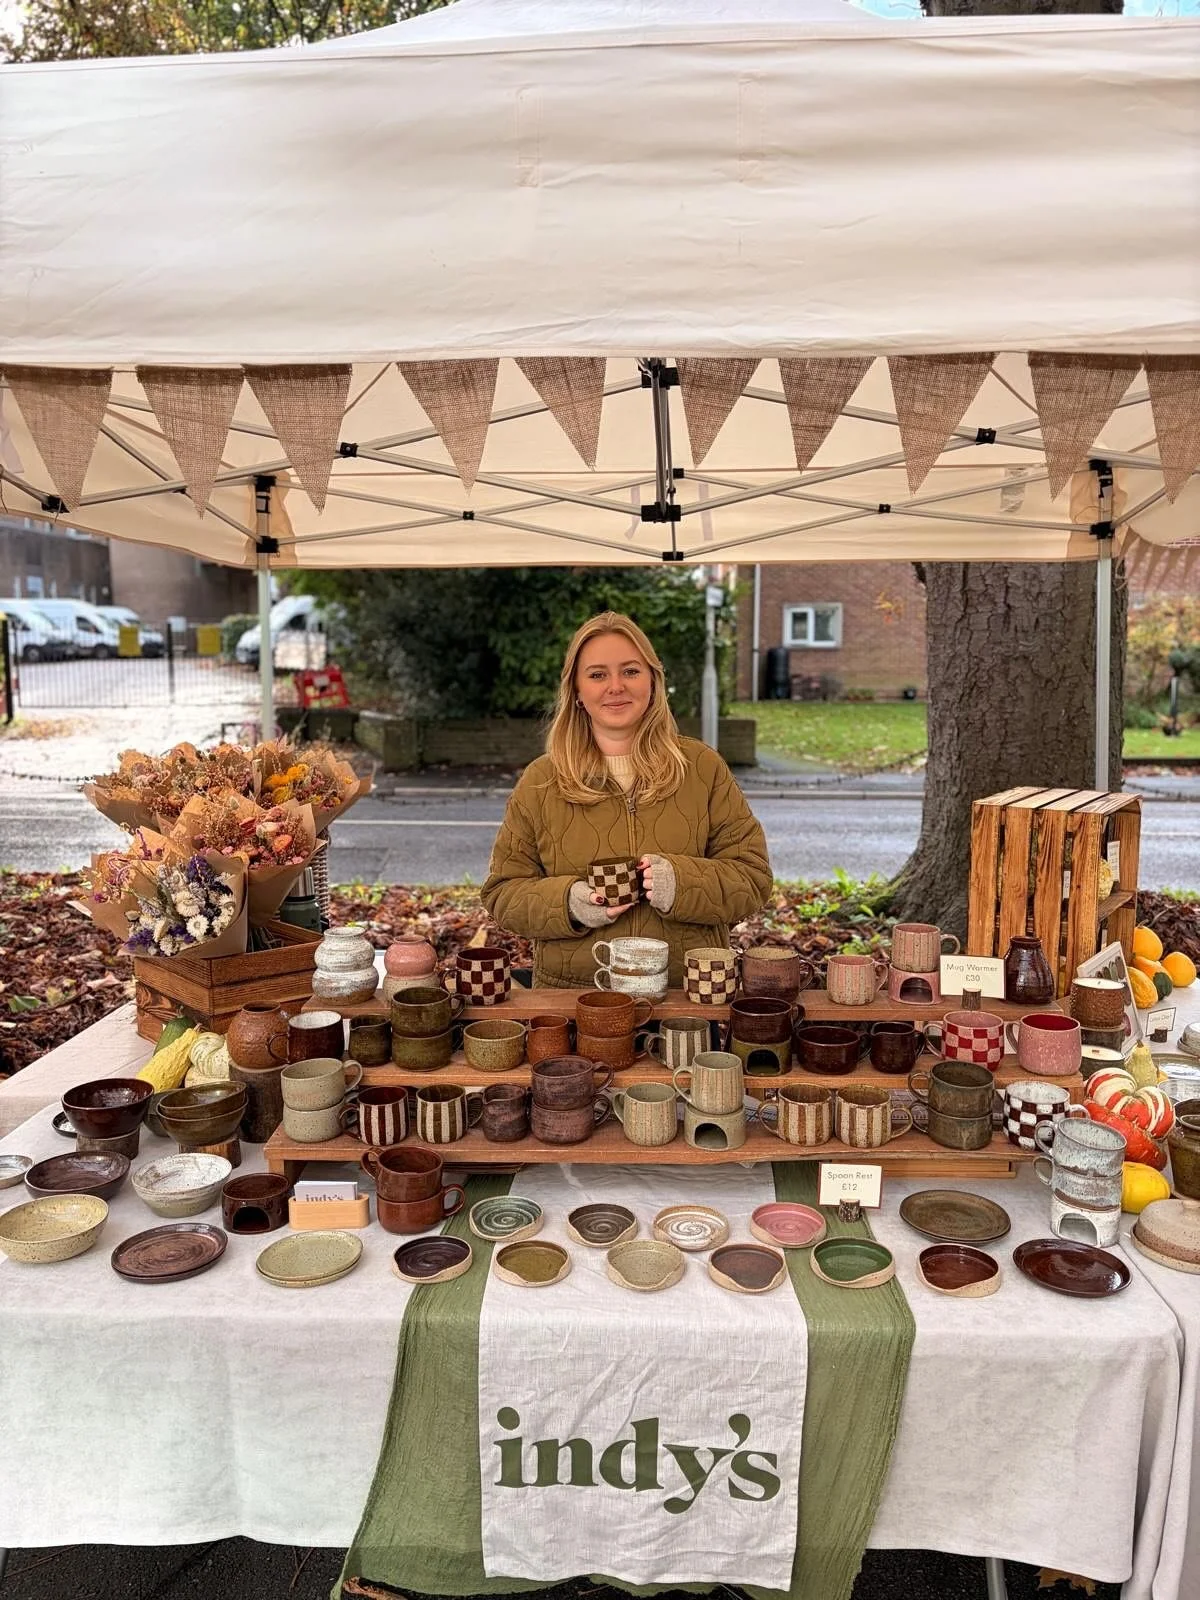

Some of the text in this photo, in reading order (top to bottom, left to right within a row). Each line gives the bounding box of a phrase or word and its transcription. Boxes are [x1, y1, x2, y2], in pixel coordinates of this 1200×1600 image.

[946, 963, 998, 972] Mug Warmer
[965, 974, 981, 982] £30
[827, 1171, 873, 1181] Spoon Rest
[841, 1183, 858, 1191] £12
[493, 1406, 781, 1515] indy's
